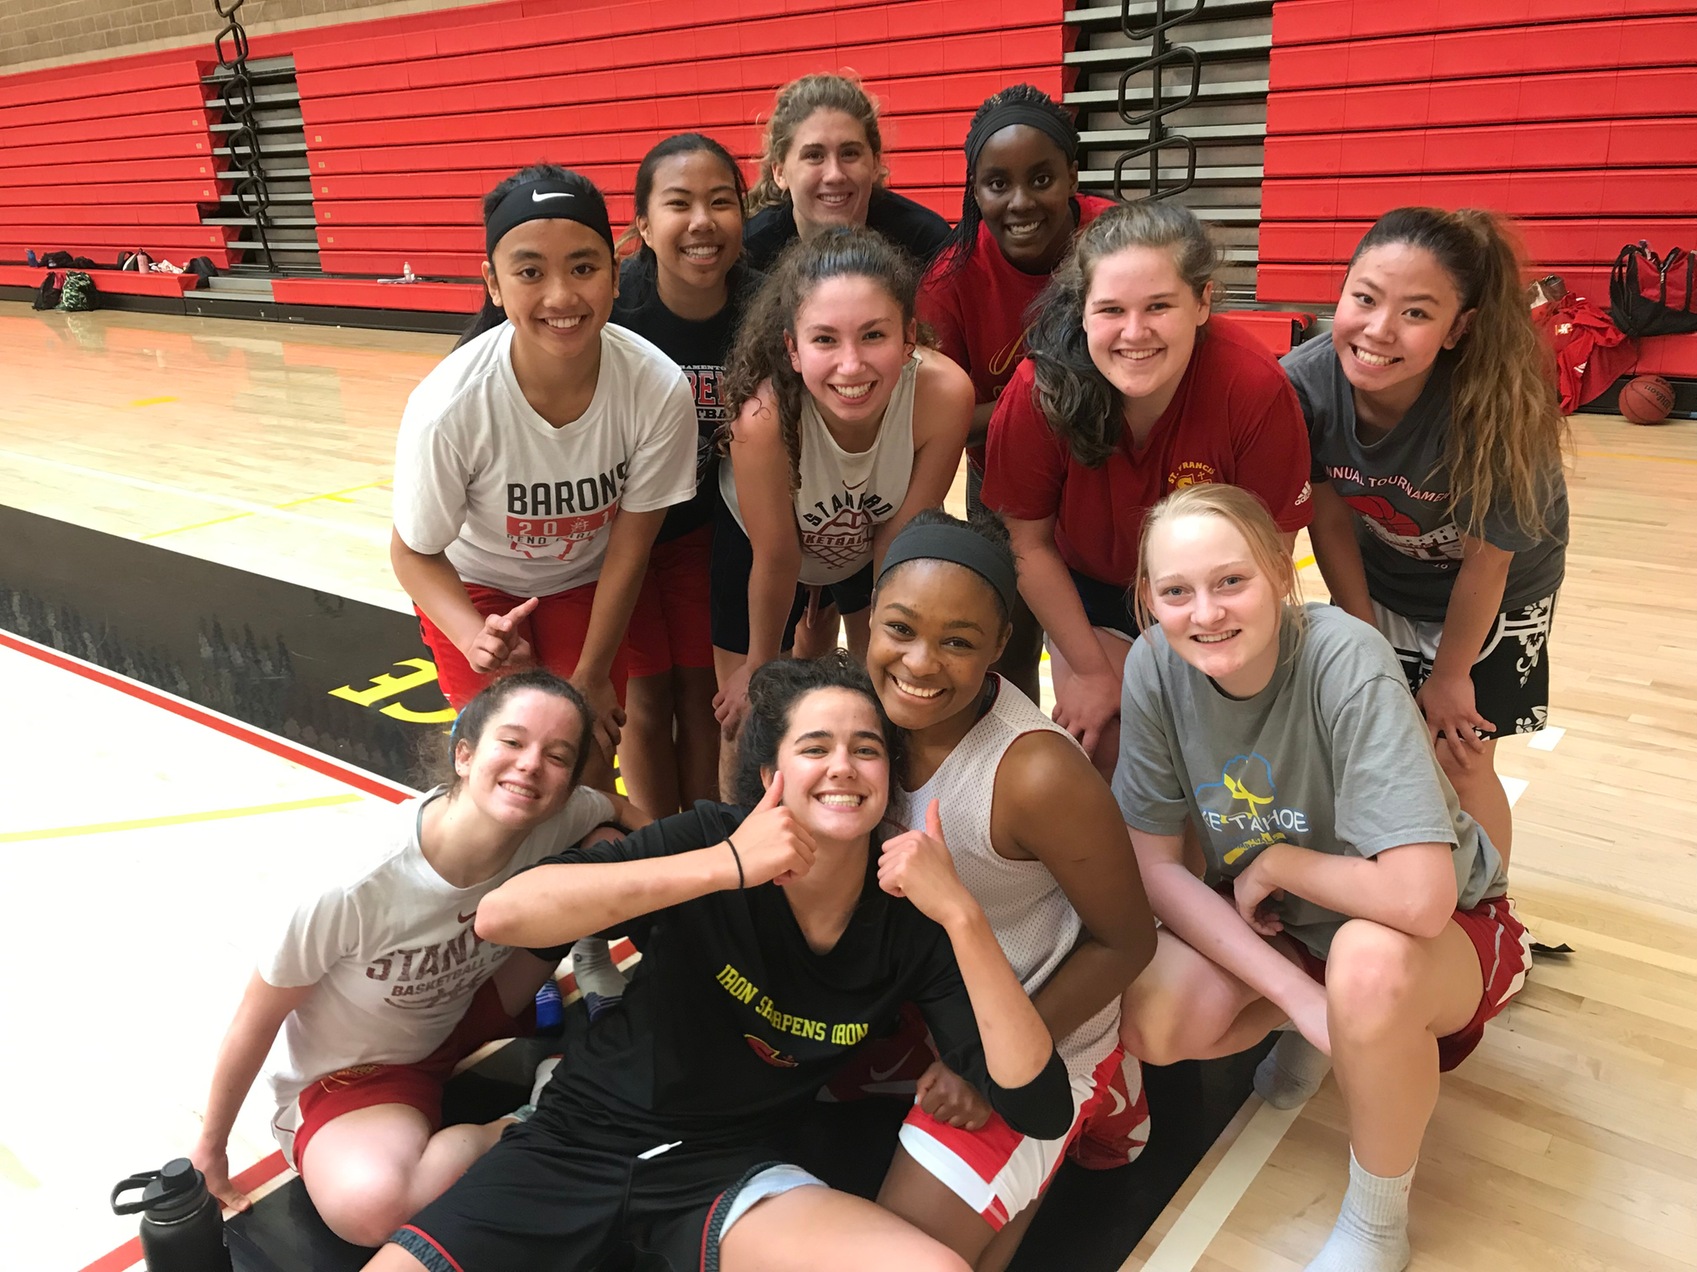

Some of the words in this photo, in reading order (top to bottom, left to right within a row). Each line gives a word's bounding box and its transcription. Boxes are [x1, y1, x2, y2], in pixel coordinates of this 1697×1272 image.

[1228, 809, 1309, 833] TAHOE
[391, 958, 485, 996] BASKETBALL
[715, 963, 759, 1005] IRON
[831, 1023, 869, 1046] IRON
